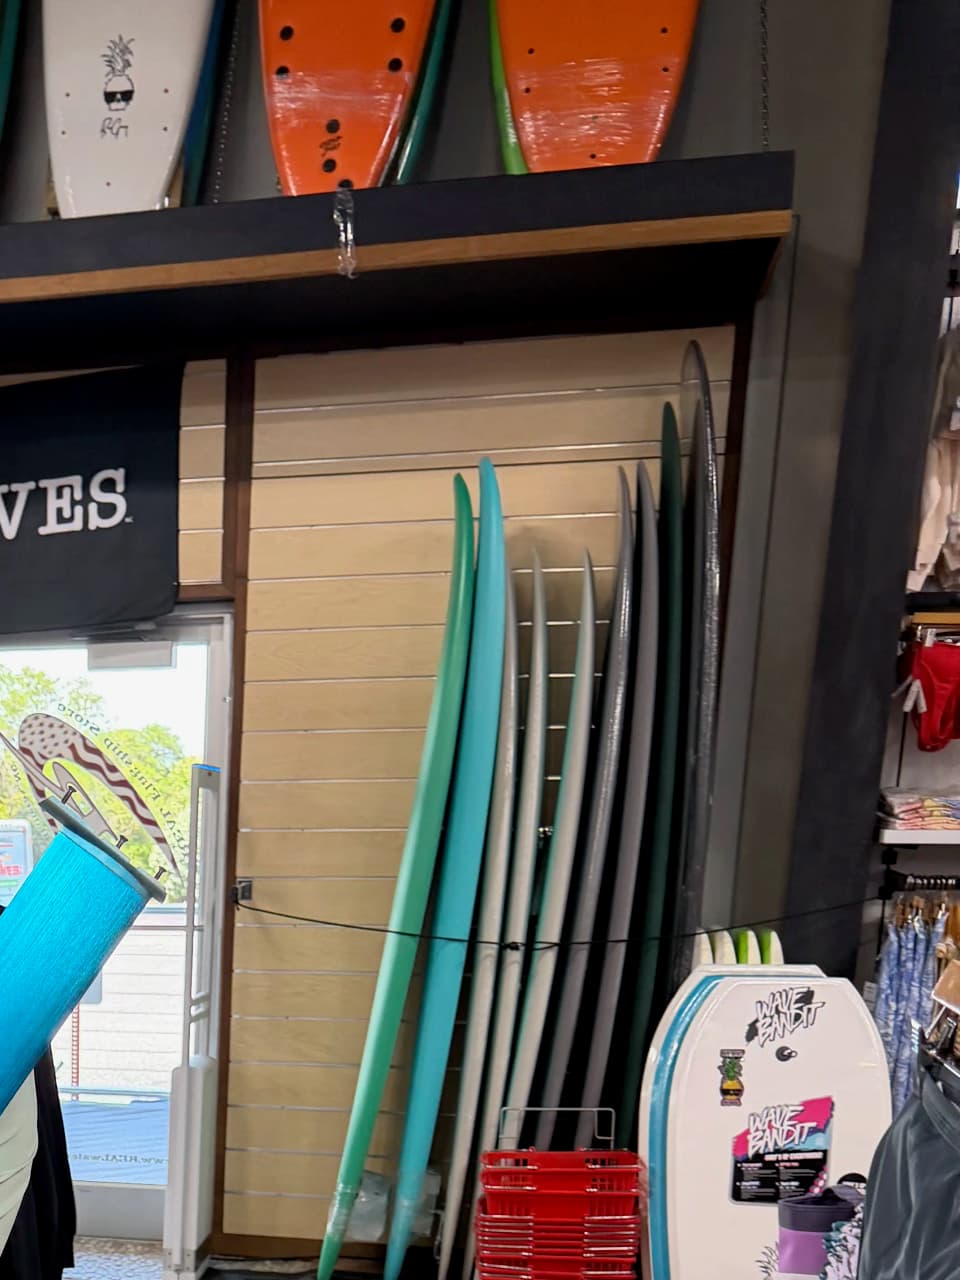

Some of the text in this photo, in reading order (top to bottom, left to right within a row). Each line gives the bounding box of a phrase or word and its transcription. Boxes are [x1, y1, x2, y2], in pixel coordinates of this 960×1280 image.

[756, 986, 810, 1018] WAVE
[756, 1001, 825, 1047] BANDIT
[749, 1104, 804, 1131] WAVE
[748, 1122, 817, 1159] BANDIT
